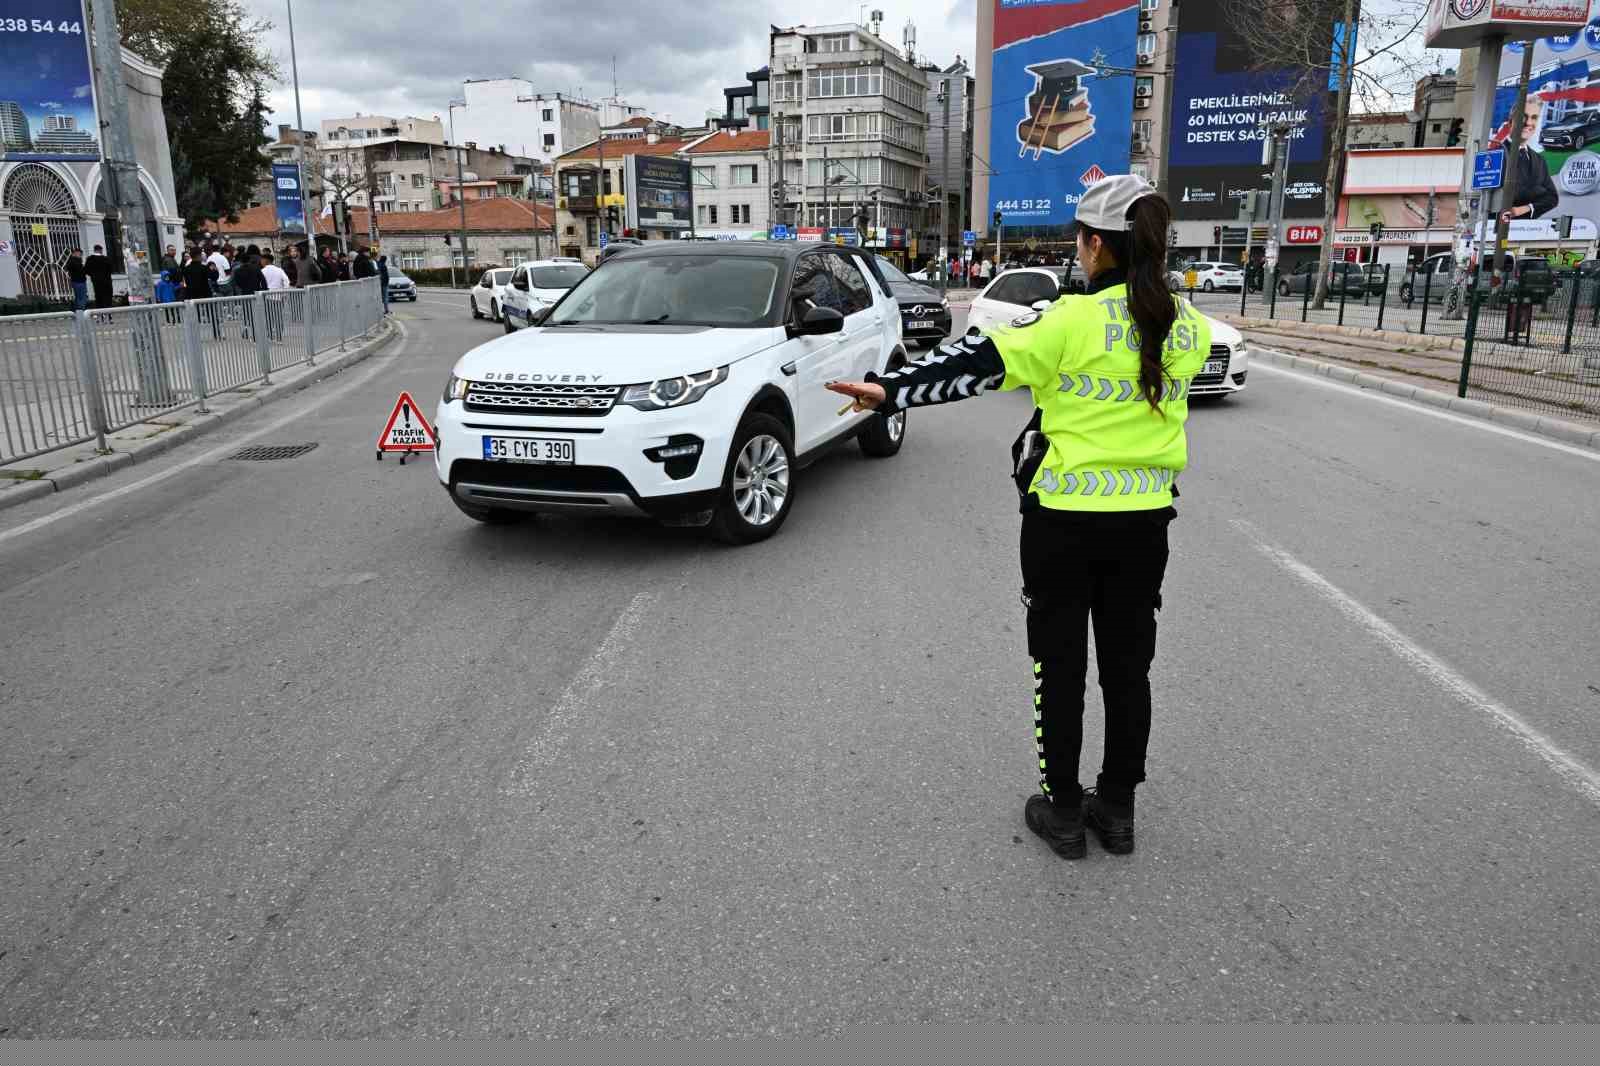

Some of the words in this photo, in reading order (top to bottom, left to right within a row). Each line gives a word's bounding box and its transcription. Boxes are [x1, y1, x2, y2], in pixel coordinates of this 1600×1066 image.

[0, 19, 28, 32] 238
[31, 19, 54, 33] 54
[58, 20, 81, 35] 44
[1553, 35, 1569, 44] Yok
[1187, 115, 1204, 127] 60
[1207, 111, 1256, 126] MİLYON
[1186, 130, 1236, 144] DESTEK
[996, 200, 1018, 210] 444
[1021, 200, 1033, 209] 51
[1036, 199, 1051, 209] 22
[1290, 227, 1318, 240] BİM
[1104, 323, 1198, 353] POİSİ
[485, 372, 602, 382] DISCOVERY
[392, 436, 426, 444] KAZASI
[491, 439, 507, 456] 35
[514, 440, 538, 458] CYG
[545, 442, 571, 460] 390
